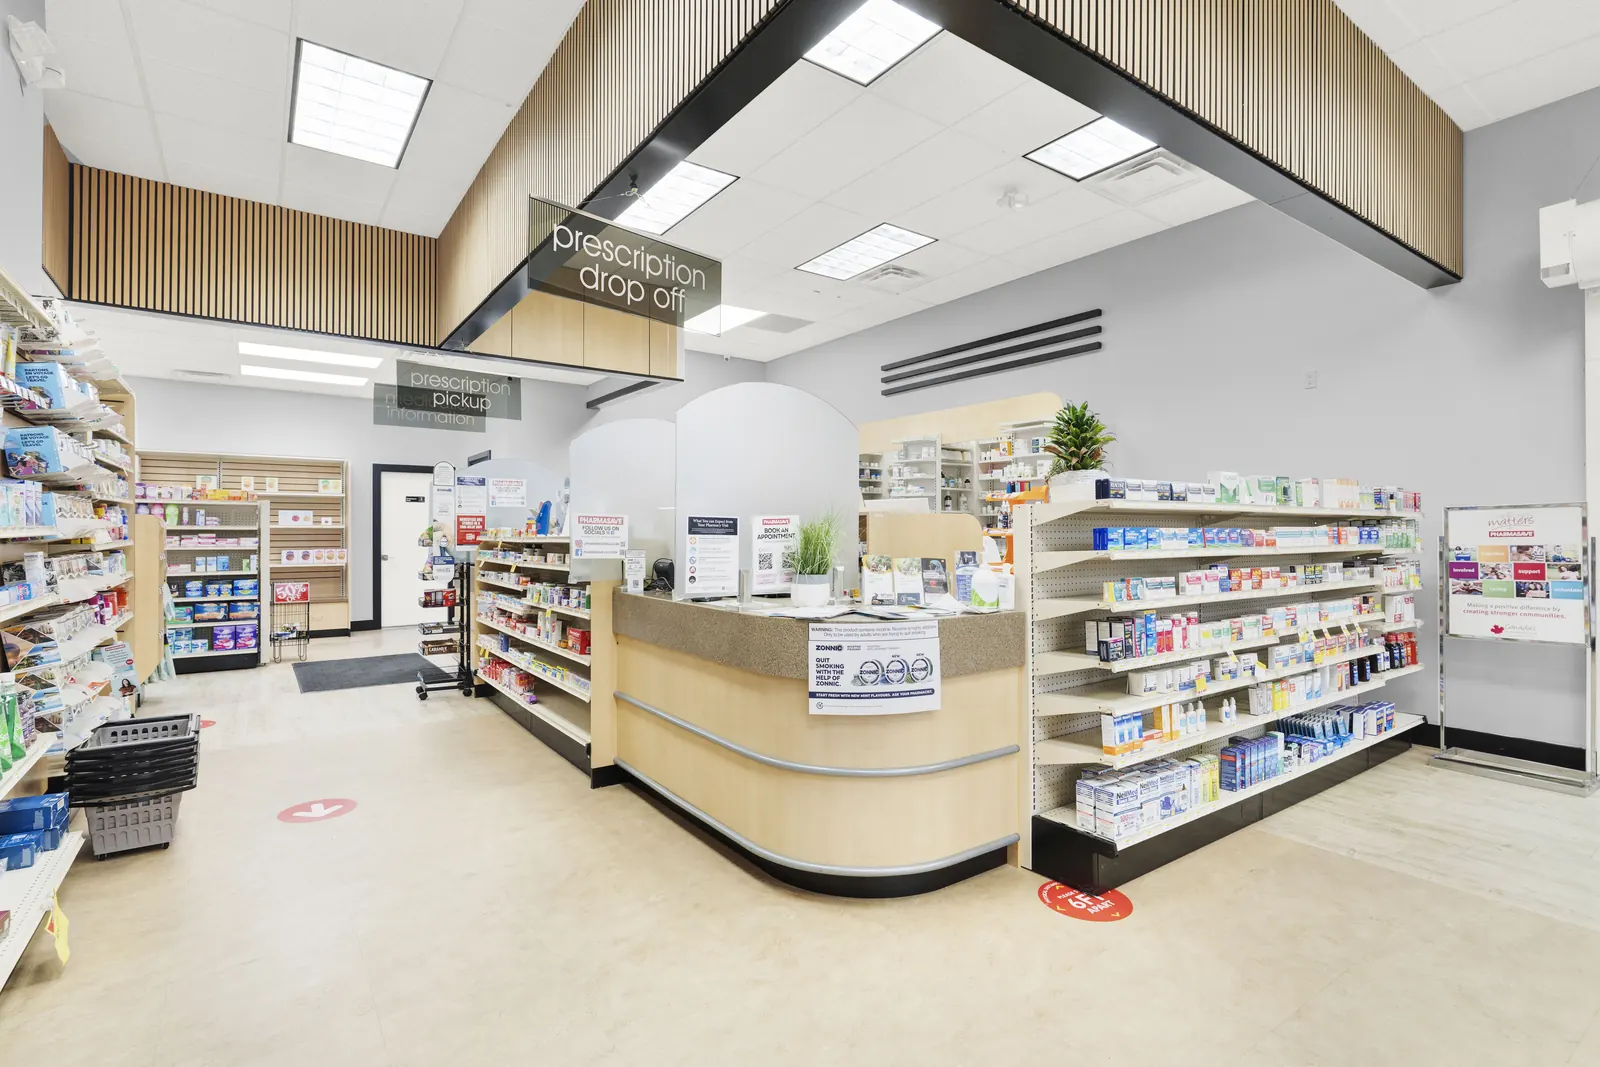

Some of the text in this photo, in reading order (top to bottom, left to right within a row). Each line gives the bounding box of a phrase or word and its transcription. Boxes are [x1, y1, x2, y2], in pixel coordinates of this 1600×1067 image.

[553, 223, 705, 290] prescription
[580, 263, 685, 312] drop off
[411, 371, 511, 395] prescription
[433, 391, 492, 412] pickup
[386, 406, 475, 426] information
[1488, 516, 1534, 527] matters
[277, 584, 306, 599] 50%
[287, 592, 301, 602] OFF
[1140, 779, 1158, 788] NeilMed
[1117, 788, 1138, 799] NeilMed
[1087, 900, 1115, 914] APART
